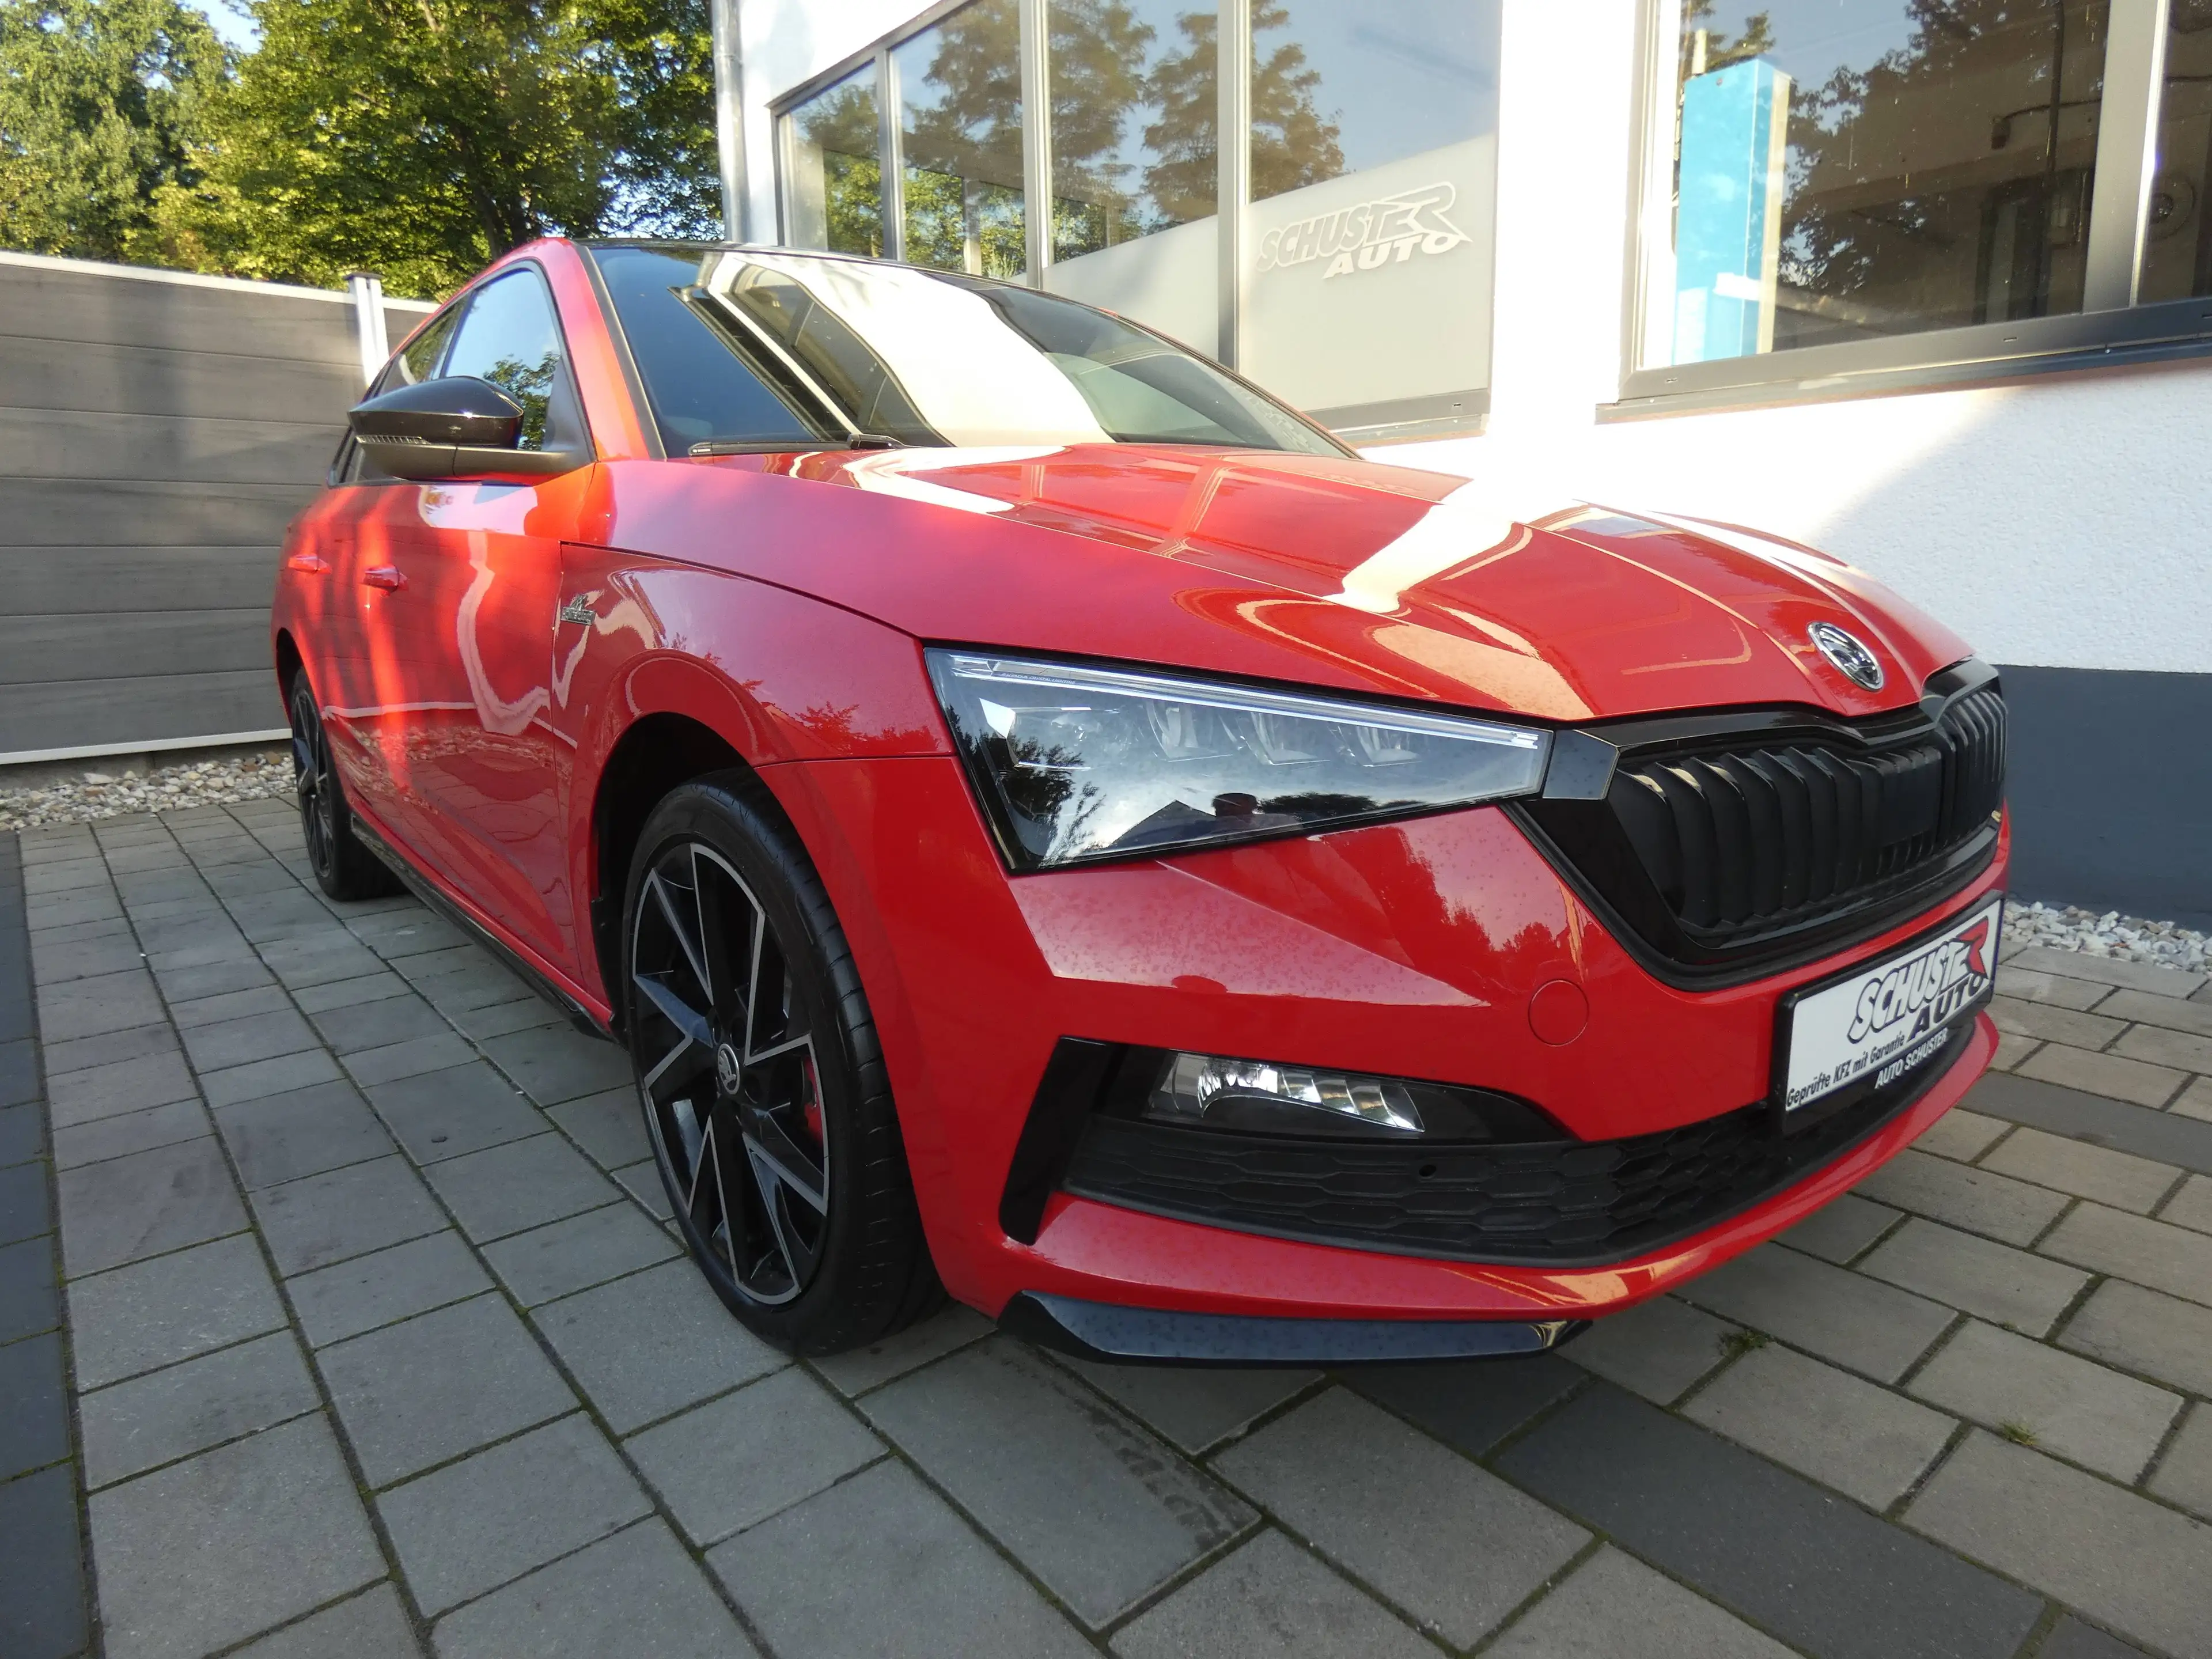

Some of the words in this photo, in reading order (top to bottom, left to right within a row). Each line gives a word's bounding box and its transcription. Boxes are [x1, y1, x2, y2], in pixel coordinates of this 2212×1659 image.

[1322, 233, 1461, 279] AUTO
[1907, 974, 1984, 1042] AUTO
[1786, 1071, 1831, 1107] Geprüfte
[1833, 1059, 1852, 1083] KFZ
[1853, 1050, 1868, 1073] mit
[1870, 1030, 1905, 1063] Garantie
[1874, 1059, 1904, 1089] AUTO
[1904, 1027, 1948, 1070] SCHUSTER
